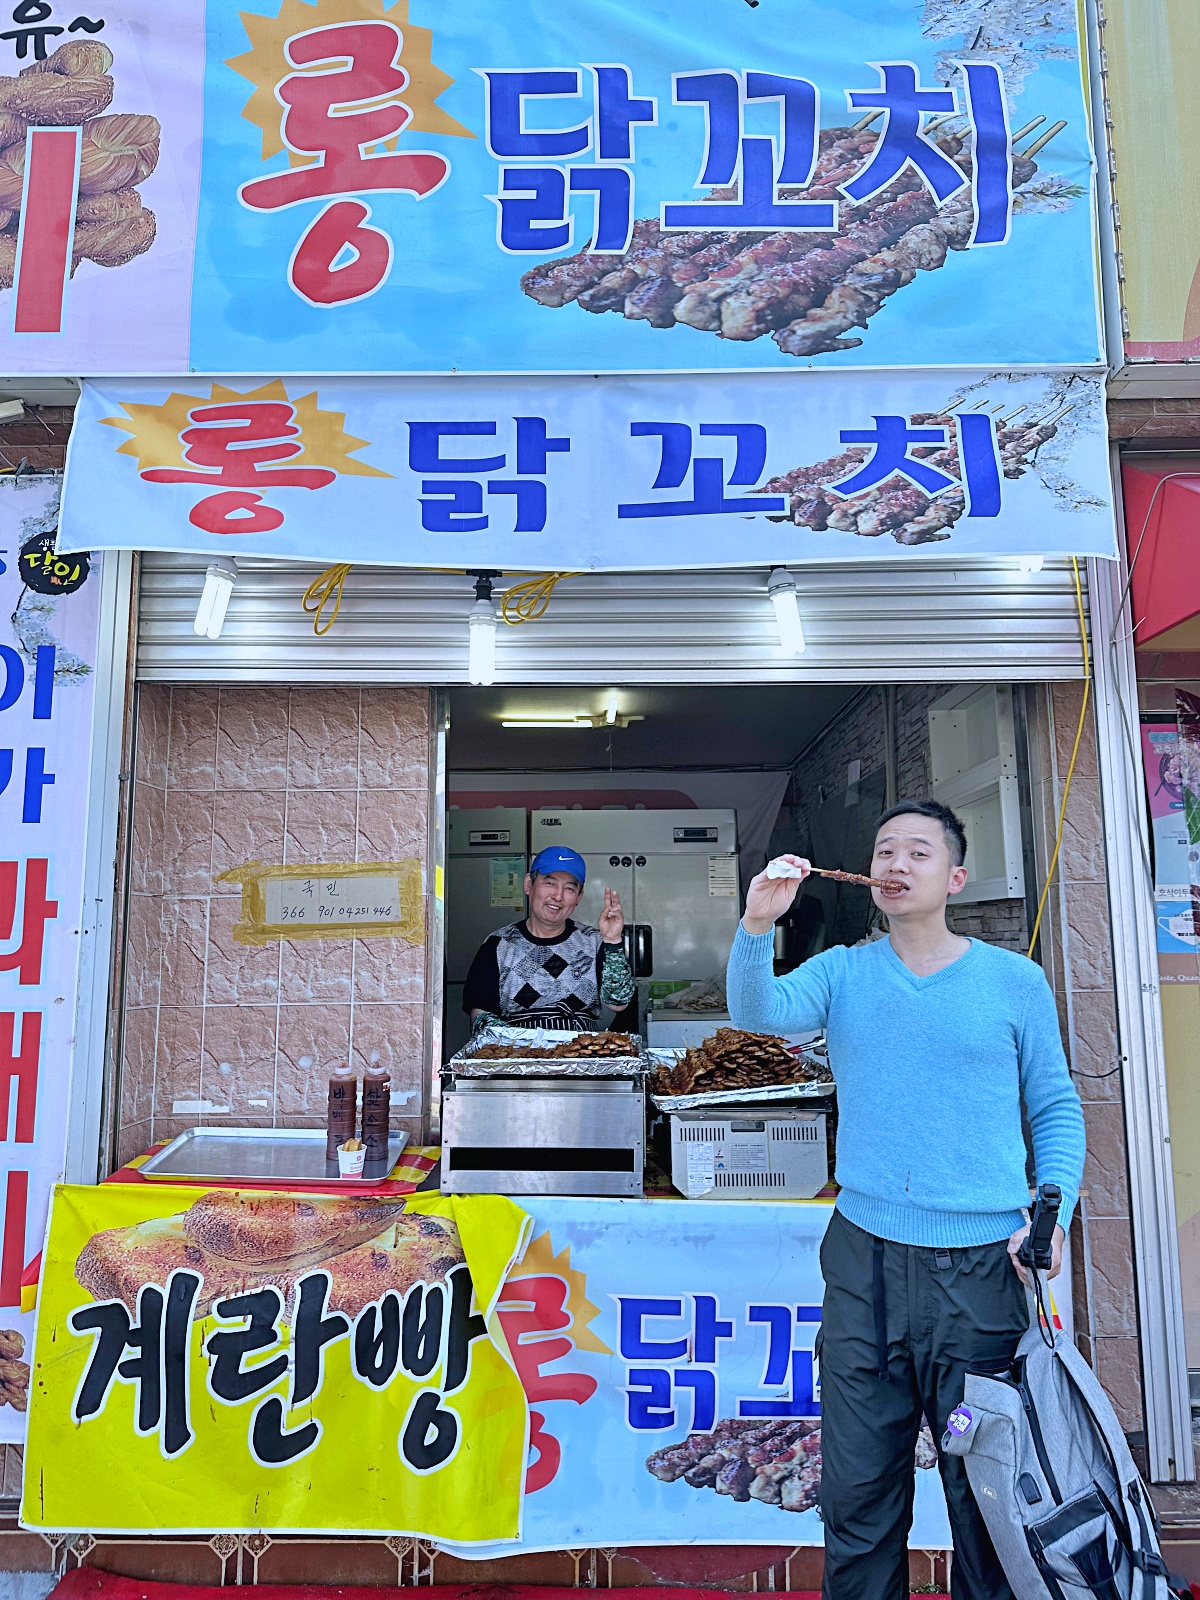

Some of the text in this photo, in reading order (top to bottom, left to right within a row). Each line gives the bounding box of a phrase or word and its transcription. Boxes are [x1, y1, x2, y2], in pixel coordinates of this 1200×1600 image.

[240, 21, 449, 306] 롱
[478, 62, 1011, 253] 닭꼬치
[140, 402, 337, 534] 롱
[23, 551, 80, 586] 달인
[282, 906, 305, 920] 366
[1158, 974, 1177, 982] aste,
[70, 1267, 488, 1472] 계란빵
[616, 1294, 820, 1432] 닭꼬
